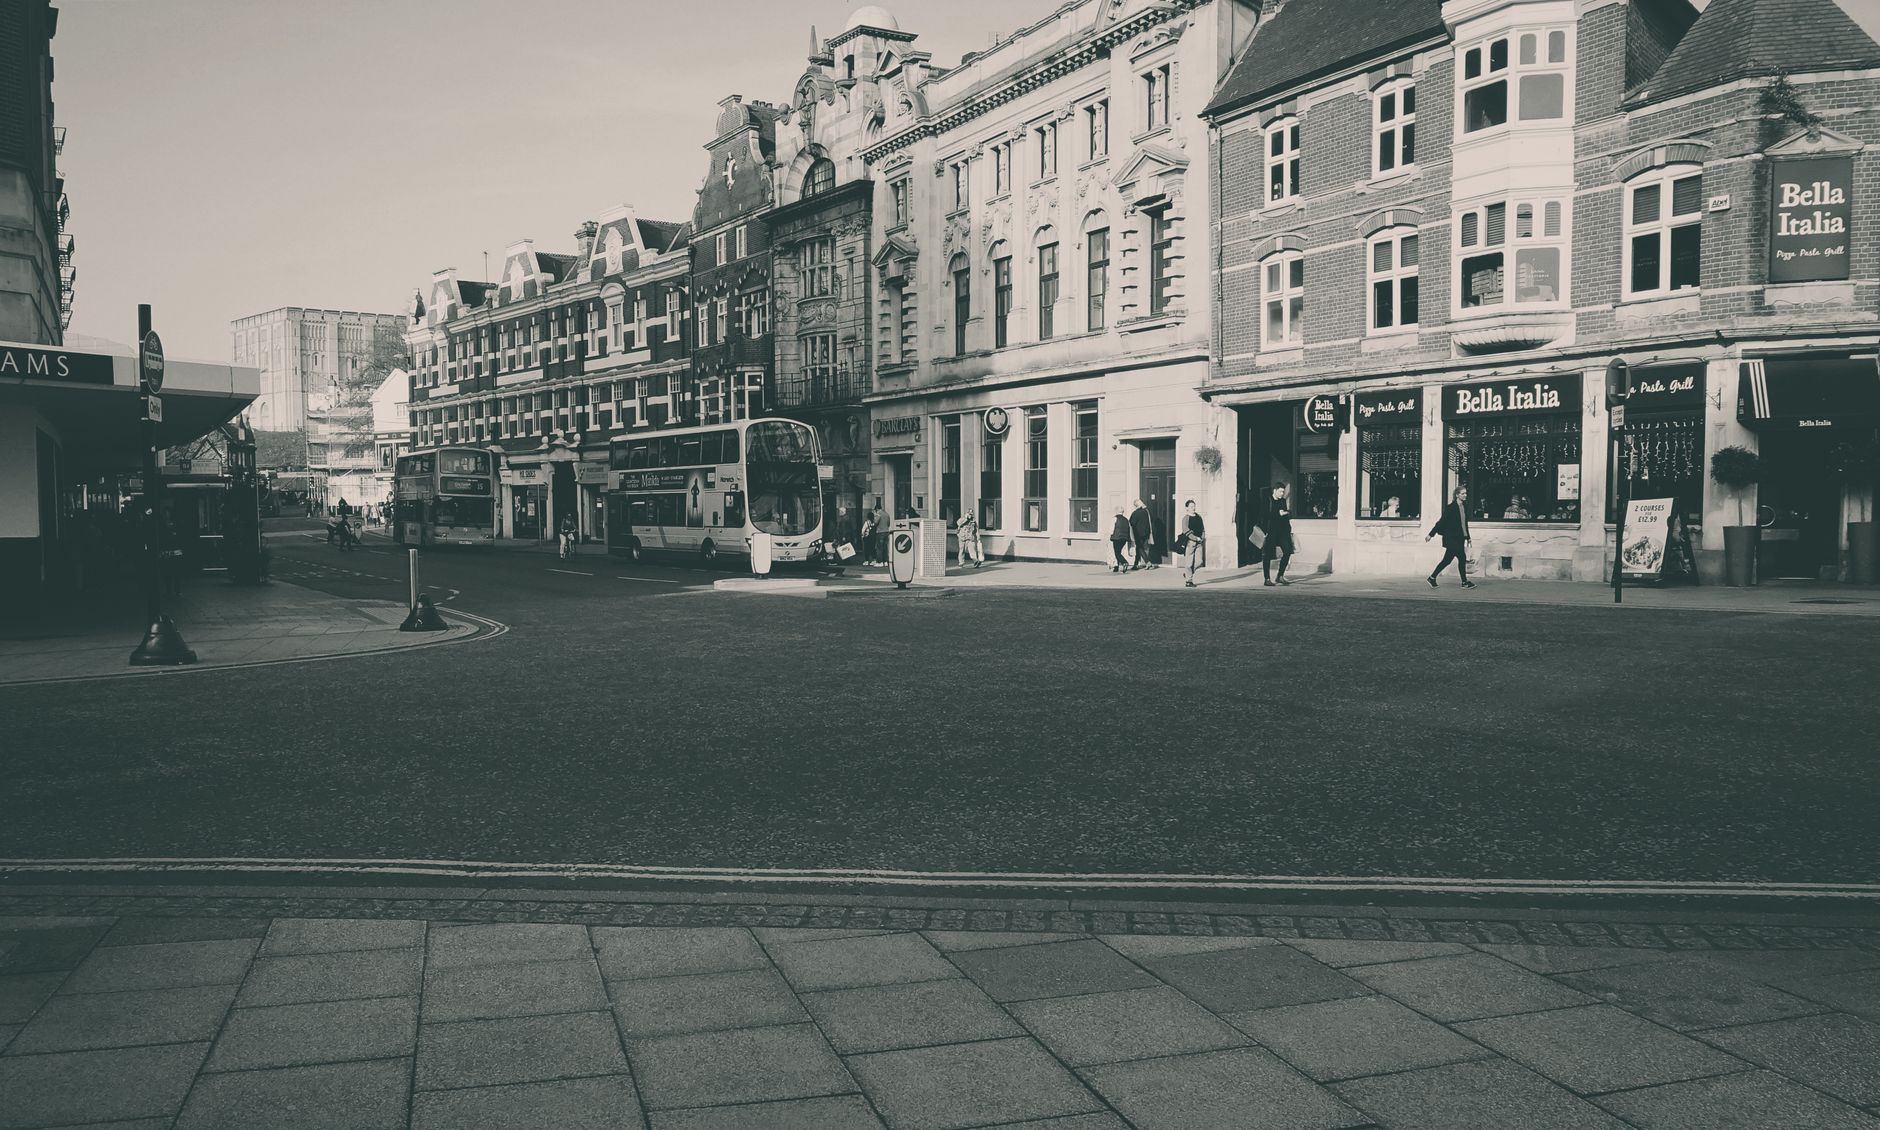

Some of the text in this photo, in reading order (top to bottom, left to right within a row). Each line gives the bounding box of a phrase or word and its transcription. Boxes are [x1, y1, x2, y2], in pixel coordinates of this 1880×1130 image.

[1779, 182, 1845, 207] Bella
[1777, 211, 1845, 236] Italia
[1776, 245, 1845, 261] Pizza Pasta Grill
[1, 351, 69, 377] AMS
[1640, 379, 1666, 394] Pasta
[1669, 376, 1695, 394] Grill
[1314, 399, 1334, 410] Bella
[1359, 398, 1415, 418] Pizza Pasta Grill
[1456, 383, 1561, 415] Bella Italia
[881, 416, 920, 434] BARCLAYS
[1314, 411, 1334, 421] Italia
[1637, 515, 1658, 523] £12.99
